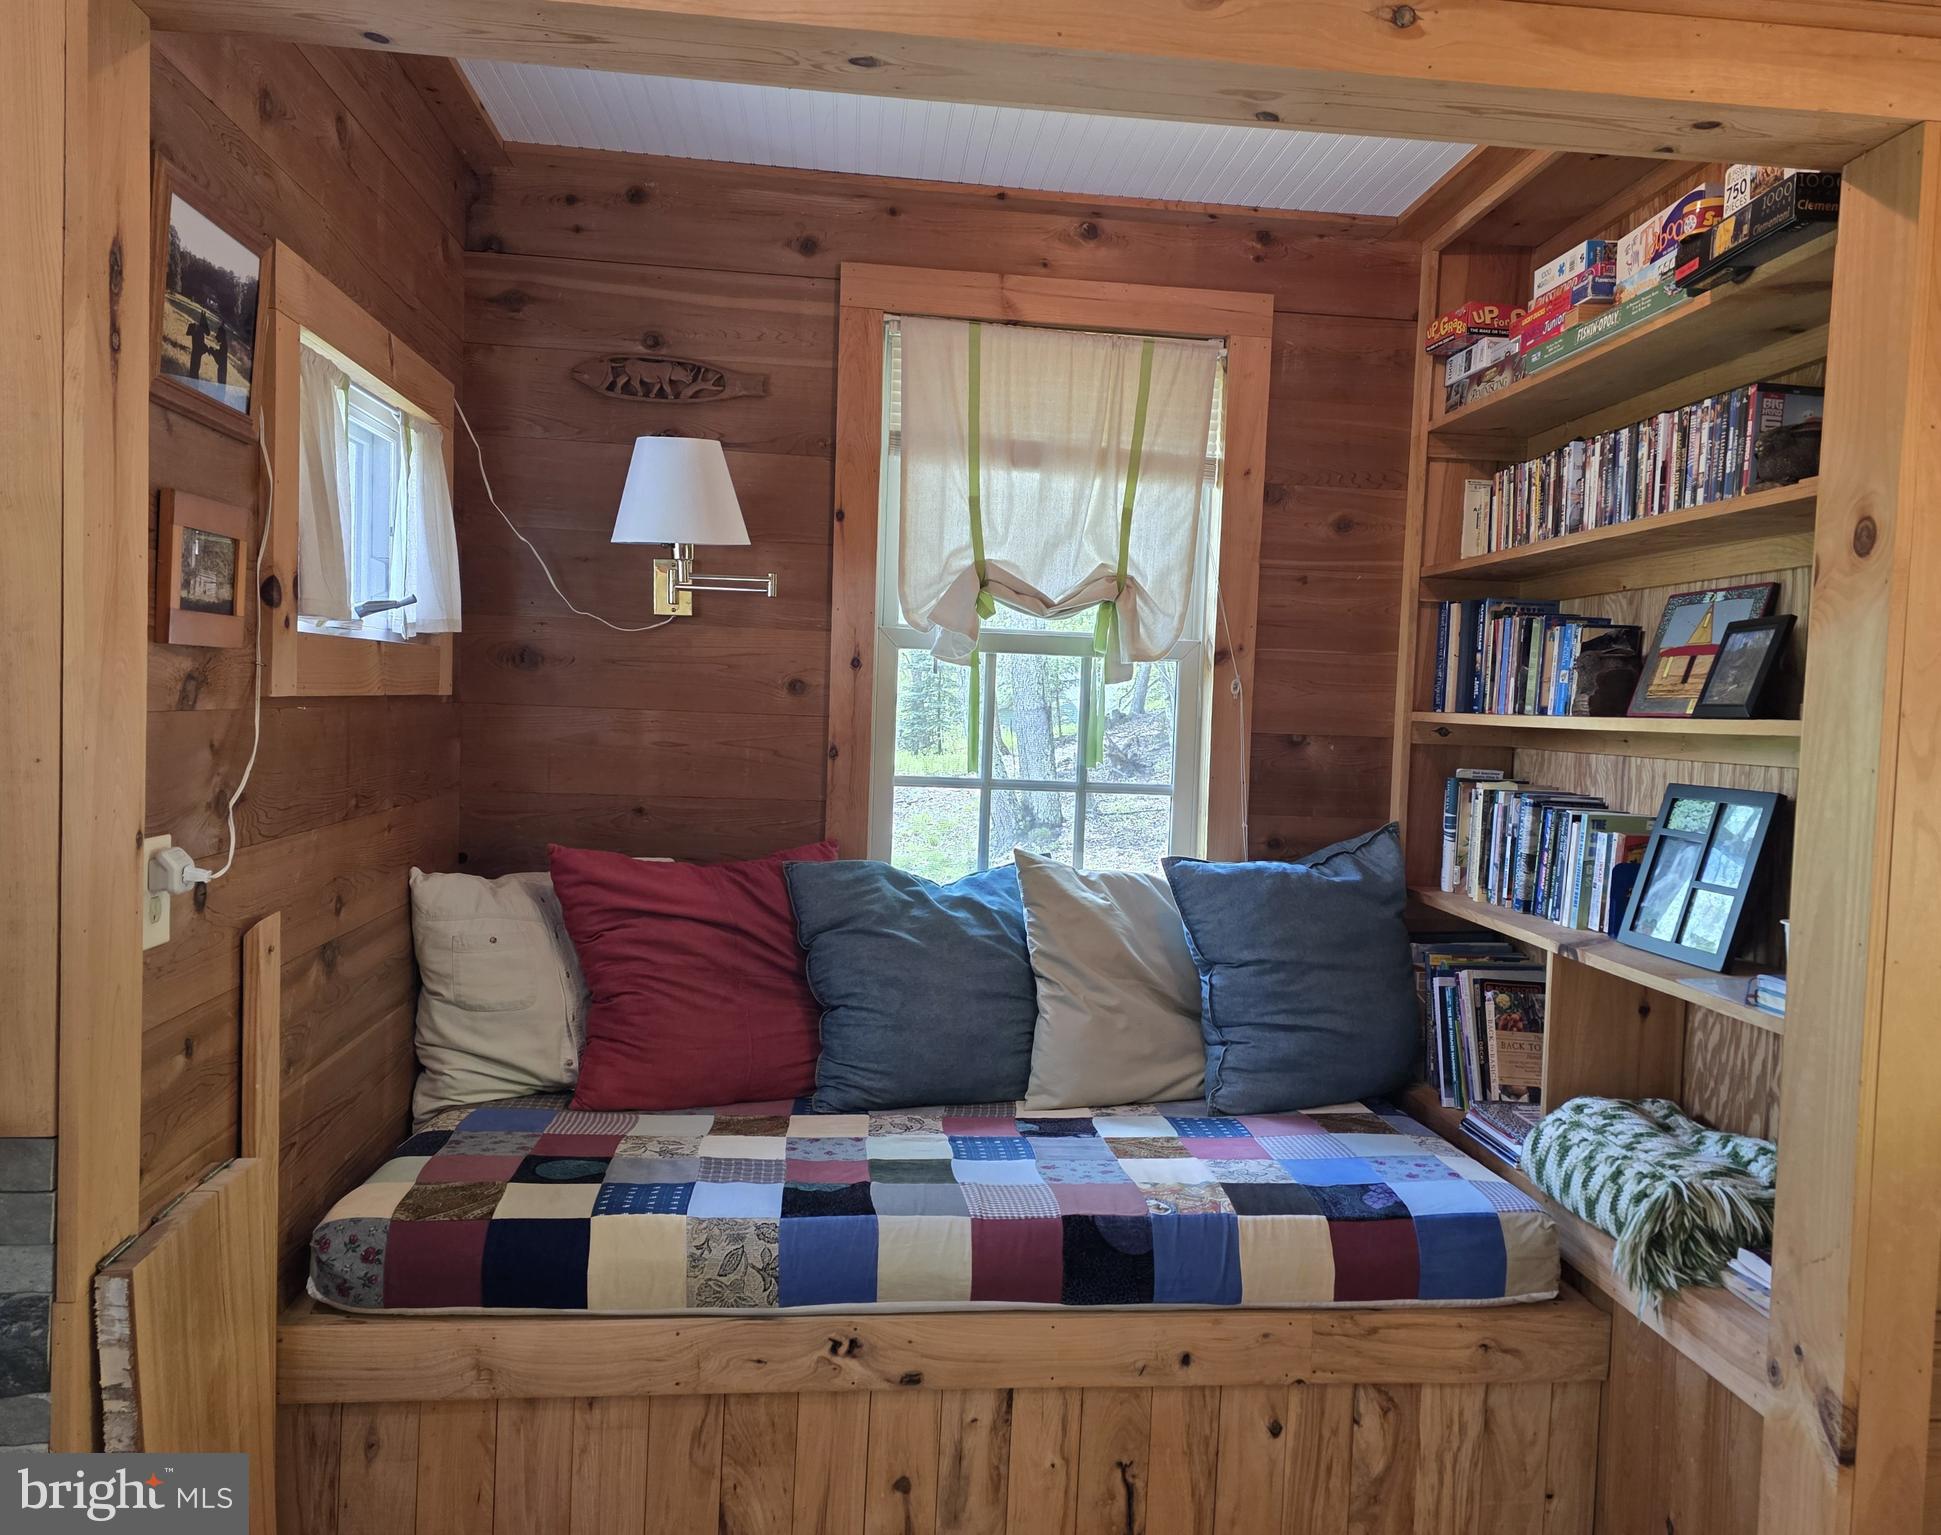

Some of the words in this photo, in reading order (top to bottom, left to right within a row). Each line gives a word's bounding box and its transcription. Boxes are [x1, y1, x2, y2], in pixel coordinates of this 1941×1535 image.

[1799, 173, 1841, 188] 100
[1726, 178, 1747, 204] 750
[1762, 181, 1793, 209] 1000
[1725, 194, 1747, 214] PIECES
[1797, 199, 1839, 212] Clemen
[1641, 214, 1684, 266] Taboo
[1472, 305, 1500, 325] UP
[1542, 312, 1566, 335] Junior
[1763, 398, 1784, 410] BIG
[1717, 431, 1726, 480] ILLUSIONIST
[1501, 1041, 1525, 1050] BACK
[1528, 1043, 1541, 1051] TO
